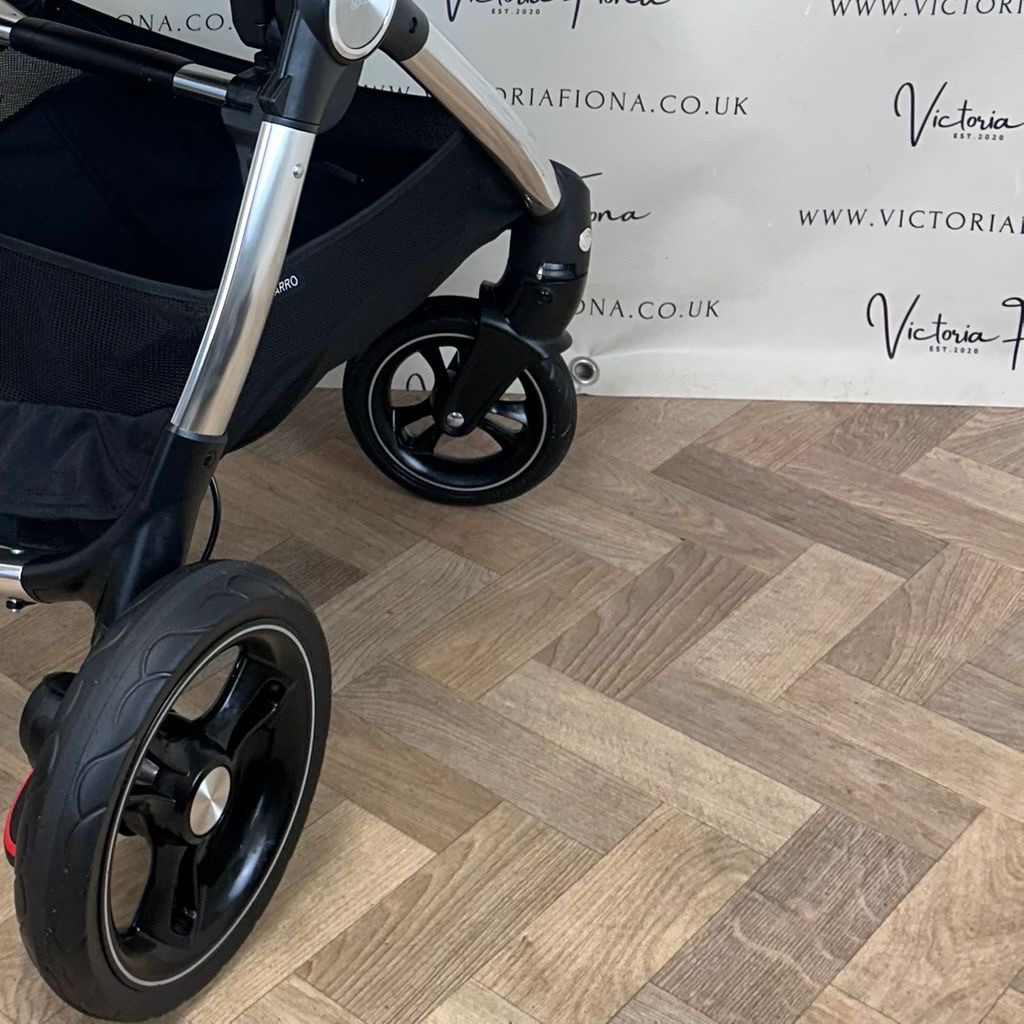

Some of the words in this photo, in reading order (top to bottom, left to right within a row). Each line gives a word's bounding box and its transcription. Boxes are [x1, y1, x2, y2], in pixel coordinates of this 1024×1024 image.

[894, 81, 1024, 147] Victoria
[953, 133, 1004, 141] EST.2020
[799, 209, 1024, 234] WWW.VICTORIA
[866, 292, 1000, 359] Victoria
[929, 345, 978, 353] EST.2020
